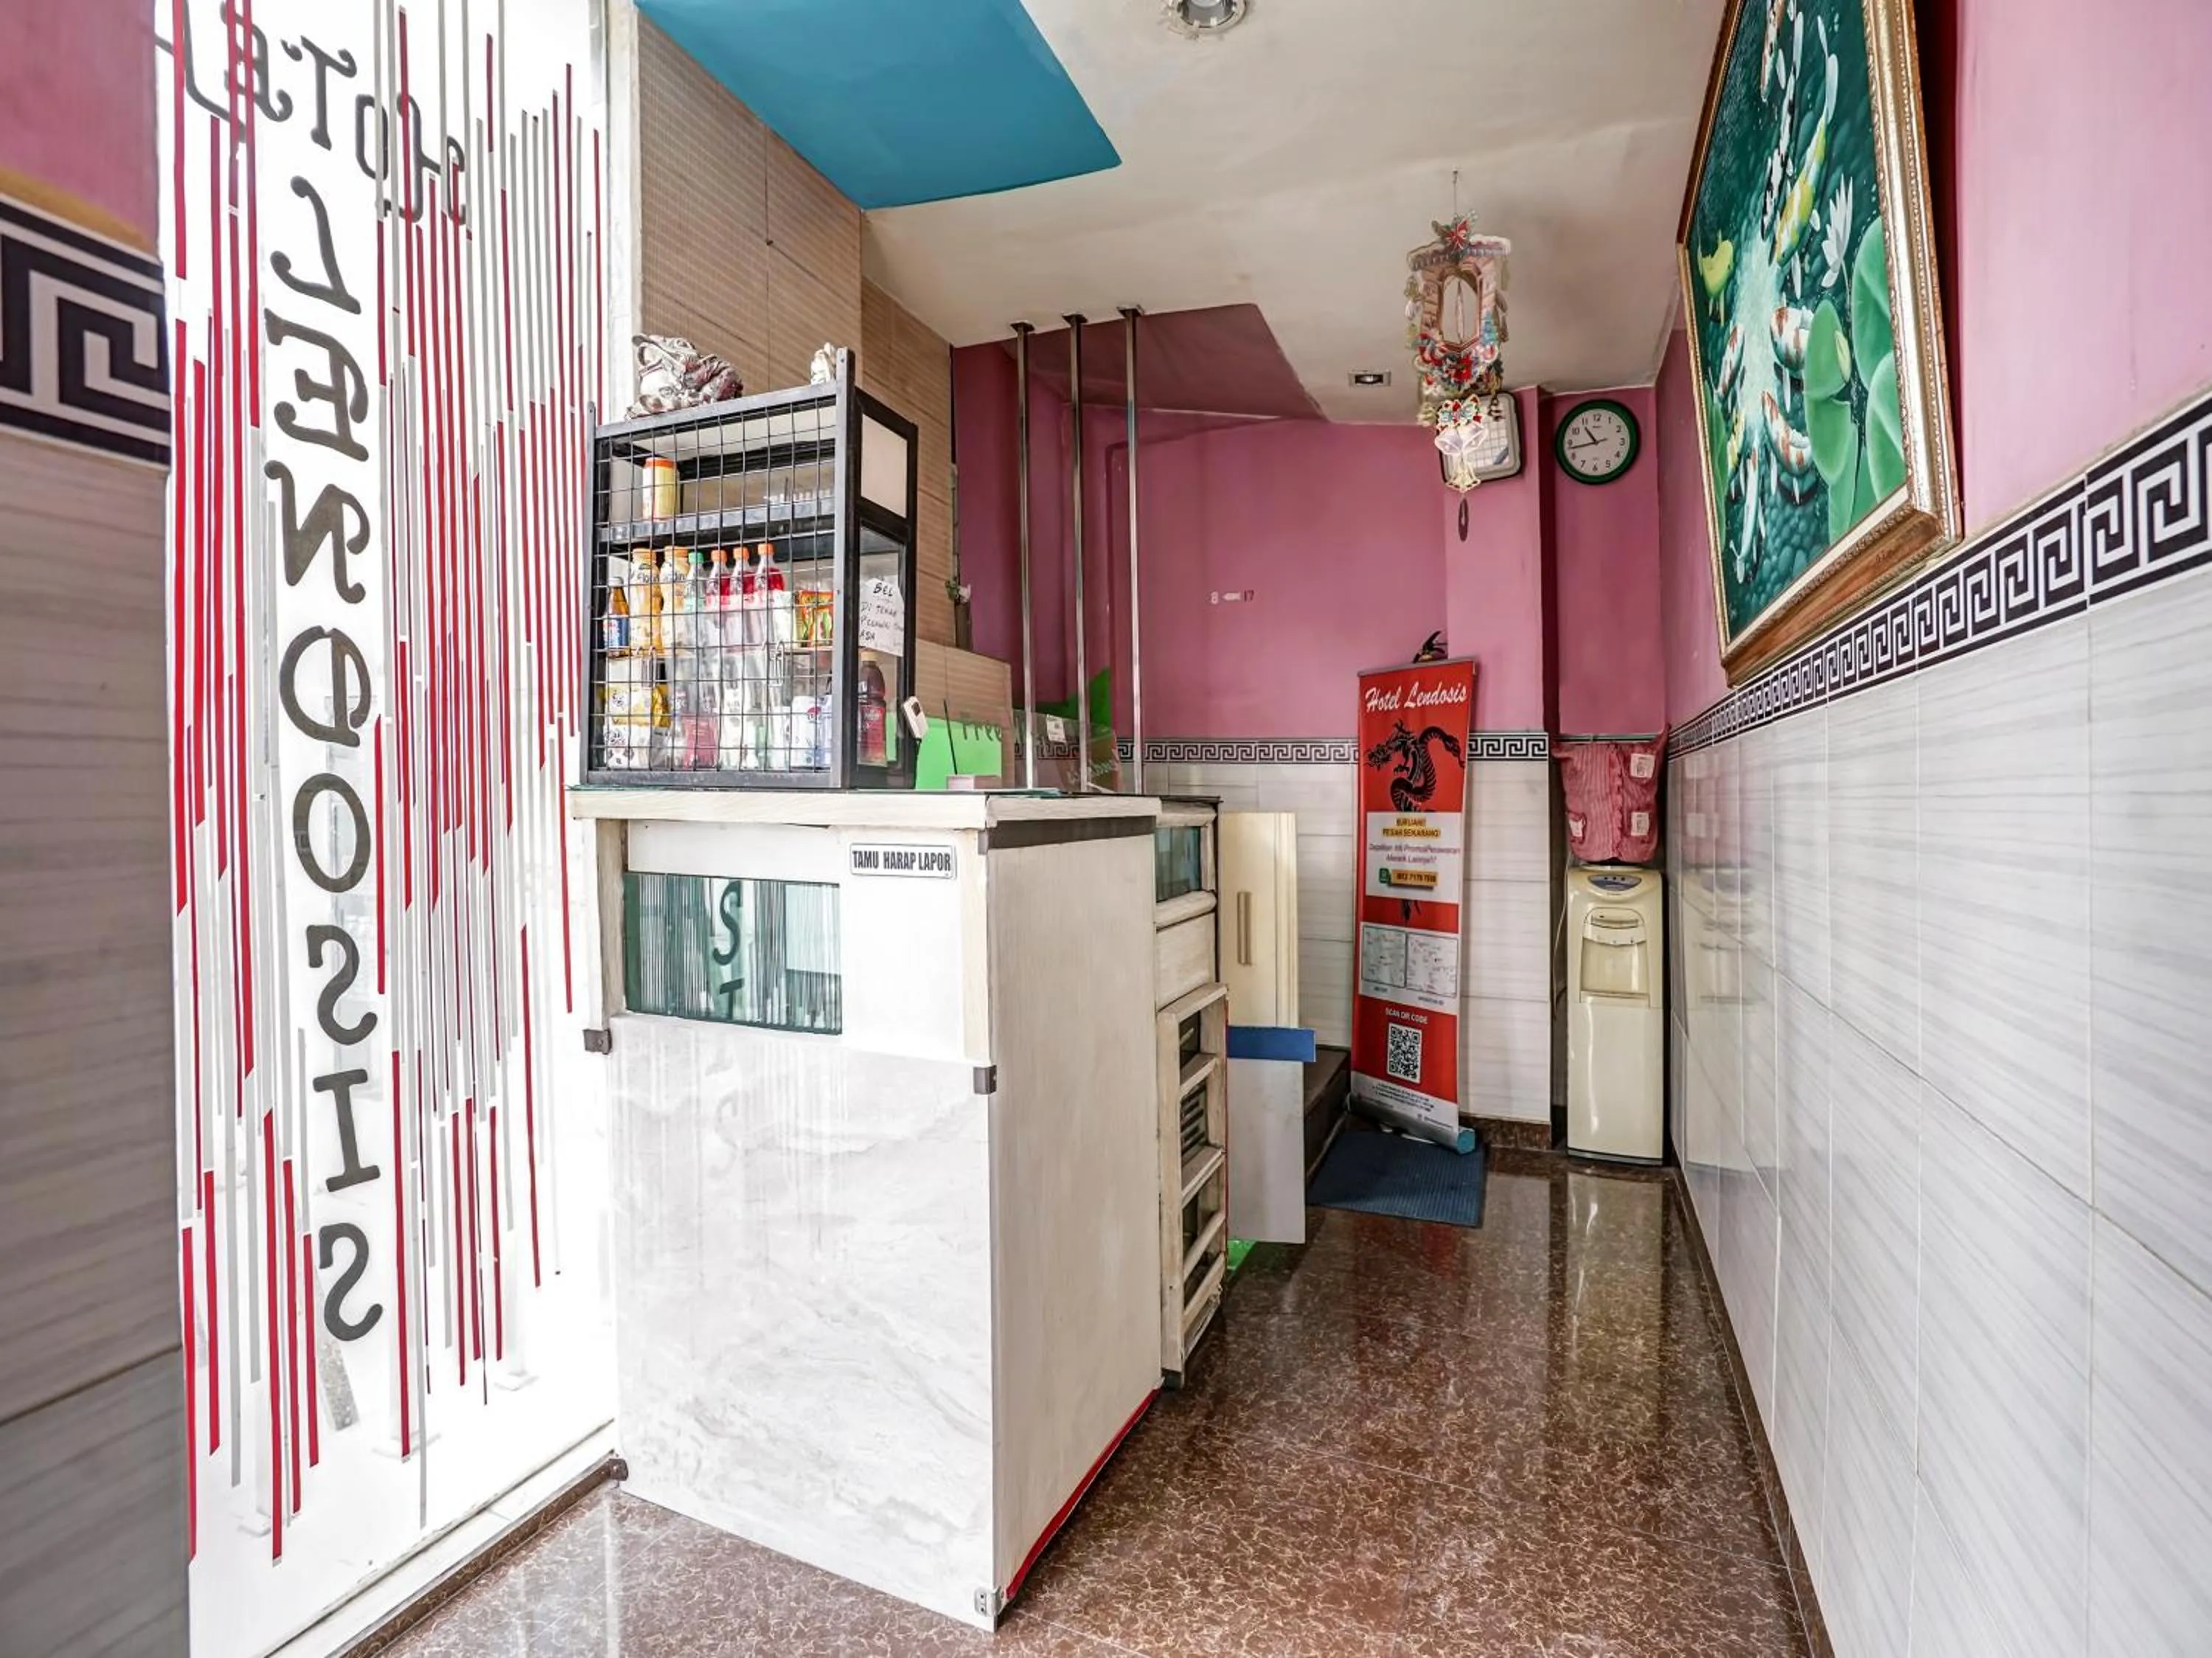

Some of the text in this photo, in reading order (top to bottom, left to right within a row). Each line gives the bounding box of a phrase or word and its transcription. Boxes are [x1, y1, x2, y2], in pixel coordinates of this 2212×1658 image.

[1365, 681, 1467, 713] Hotel Lendosis
[852, 850, 952, 872] TAMU HARAP LAPOR
